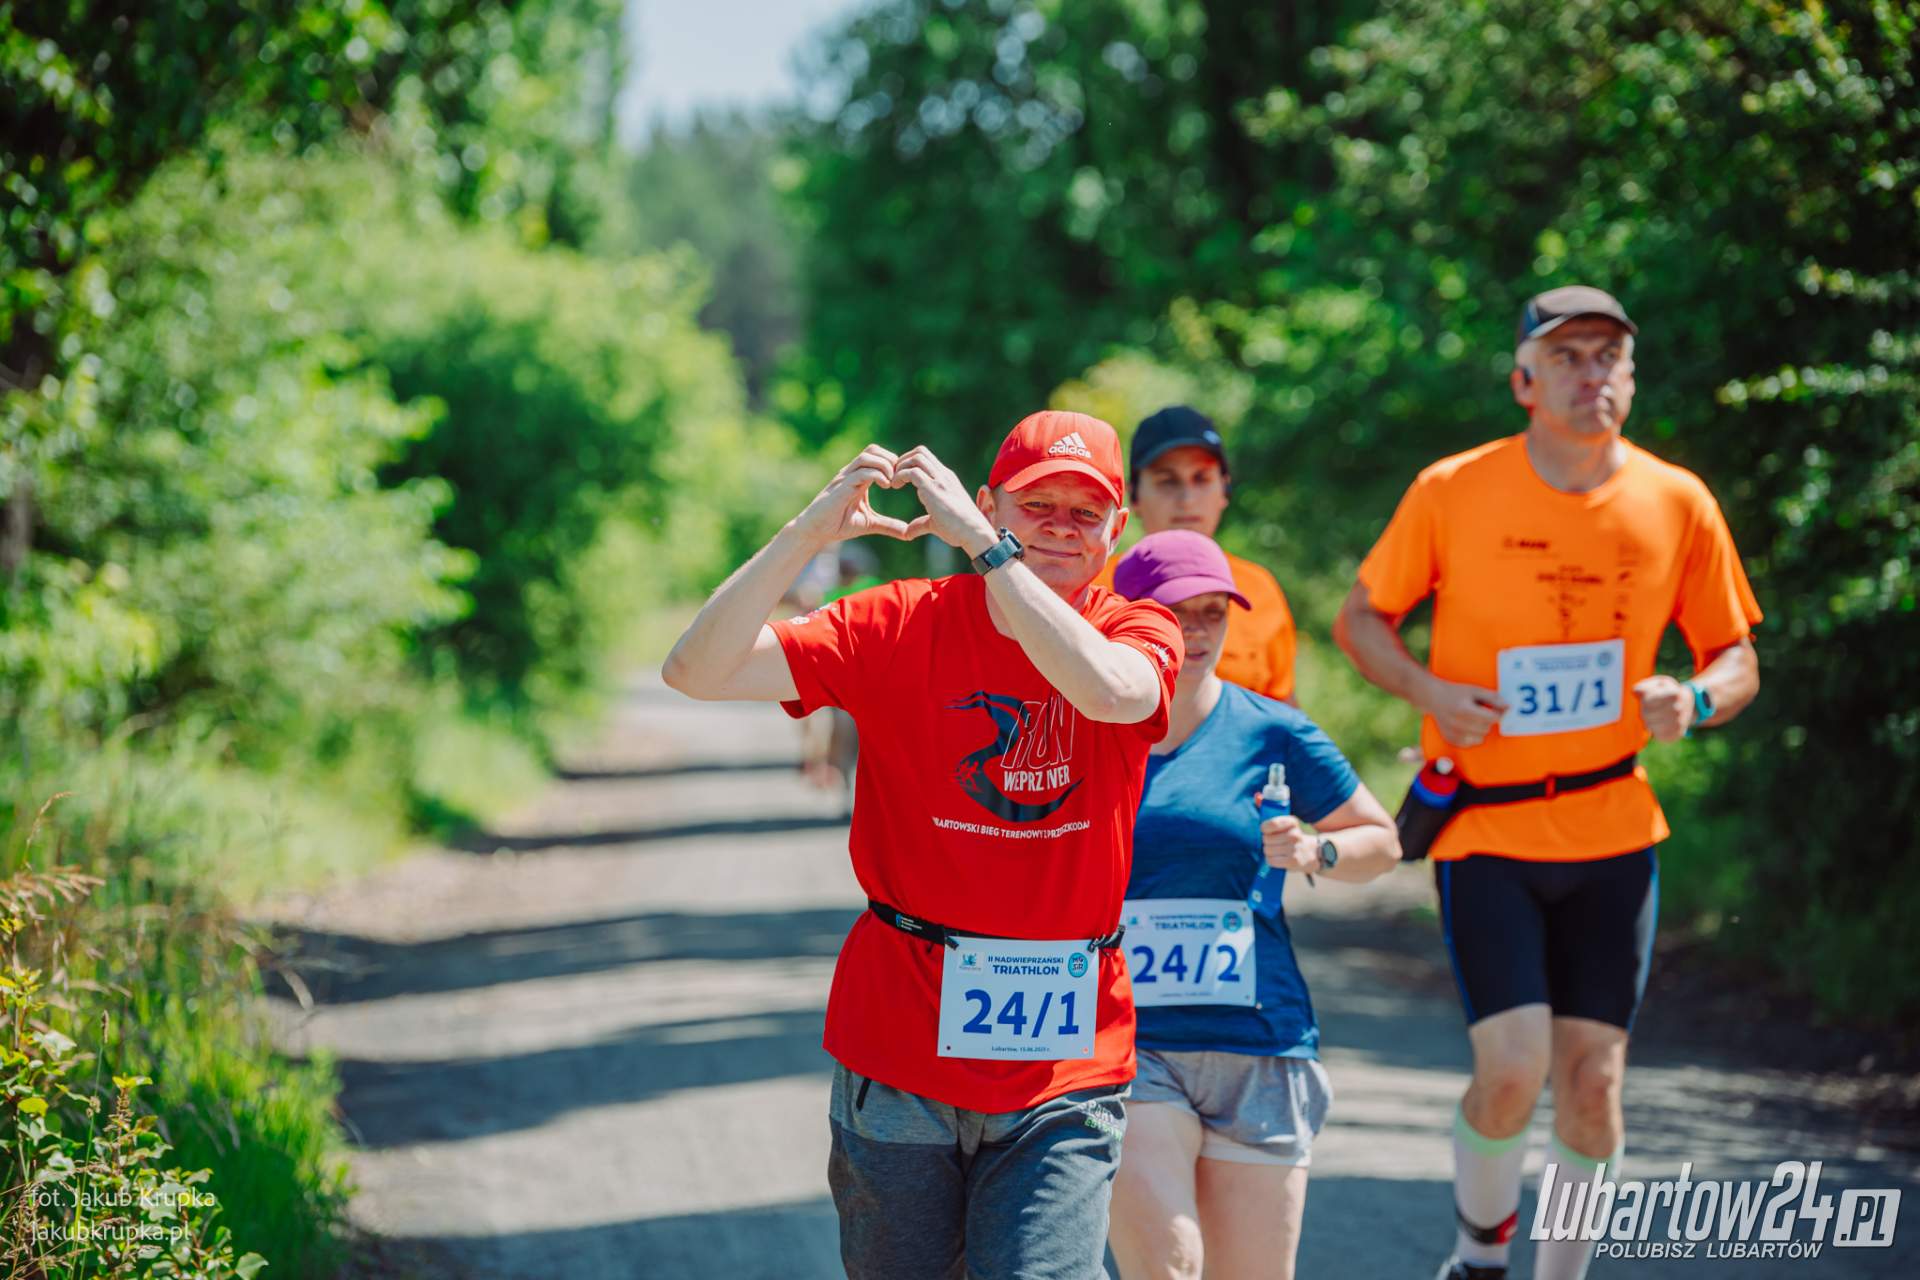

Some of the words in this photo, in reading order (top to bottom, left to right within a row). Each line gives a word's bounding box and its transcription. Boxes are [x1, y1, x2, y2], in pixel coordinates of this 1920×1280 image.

[1048, 445, 1092, 458] adidas
[1519, 680, 1607, 715] 31/1
[980, 825, 1000, 837] BIEG
[993, 964, 1060, 975] TRIATHLON
[1131, 943, 1240, 984] 24/2
[962, 988, 1079, 1038] 24/1
